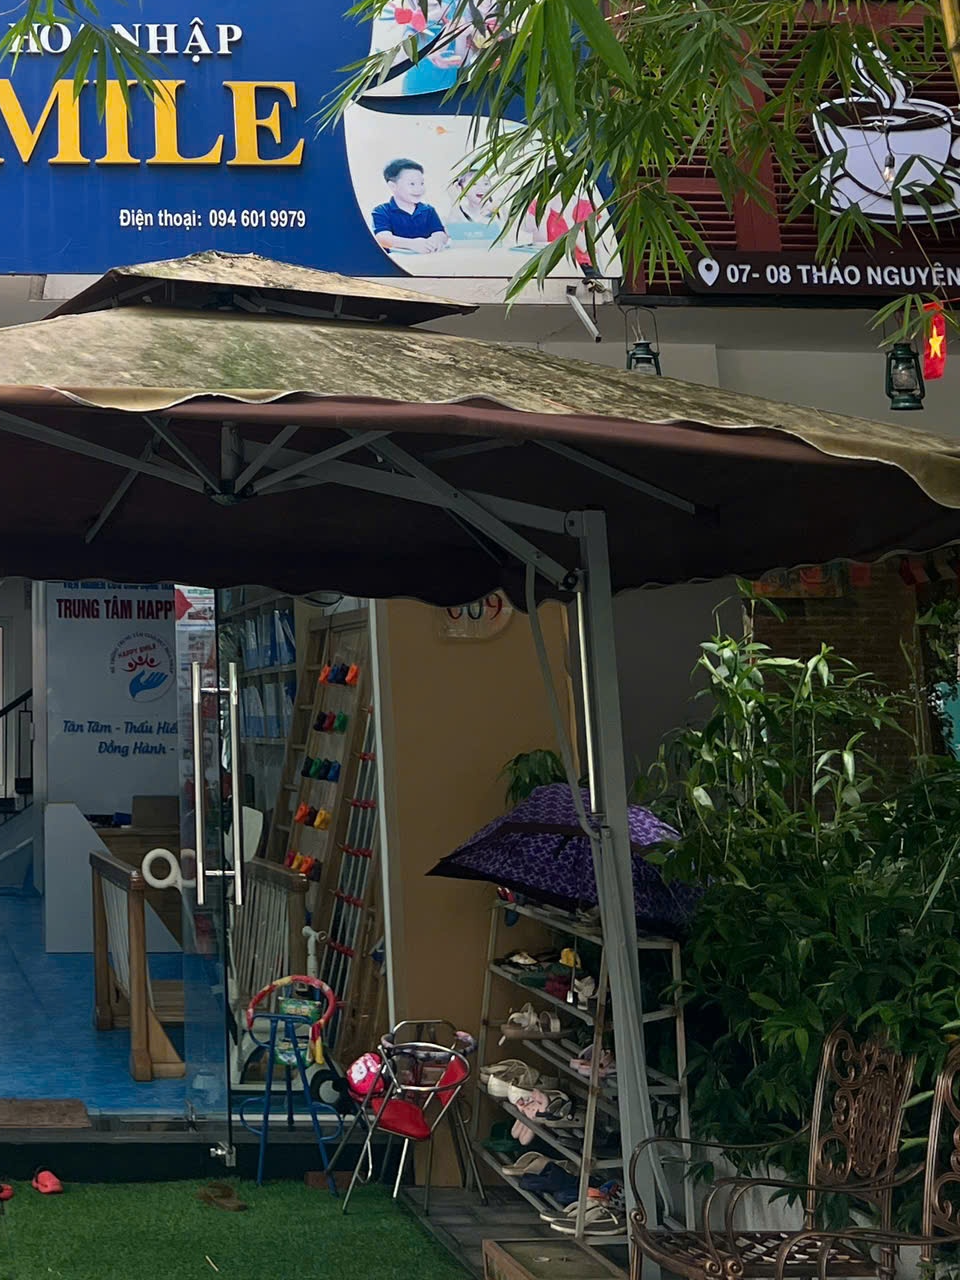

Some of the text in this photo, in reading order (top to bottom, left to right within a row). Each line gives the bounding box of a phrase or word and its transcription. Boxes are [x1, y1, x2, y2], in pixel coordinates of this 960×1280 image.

[112, 17, 243, 62] NHẬP
[119, 208, 306, 231] Điện thoại: 094 601 9979
[766, 264, 791, 284] 08
[797, 257, 861, 285] THẢO
[867, 261, 960, 287] NGUYÊN
[56, 595, 176, 620] TRUNG TÂM HAPP
[98, 740, 129, 757] Đồng
[132, 742, 166, 755] Hành
